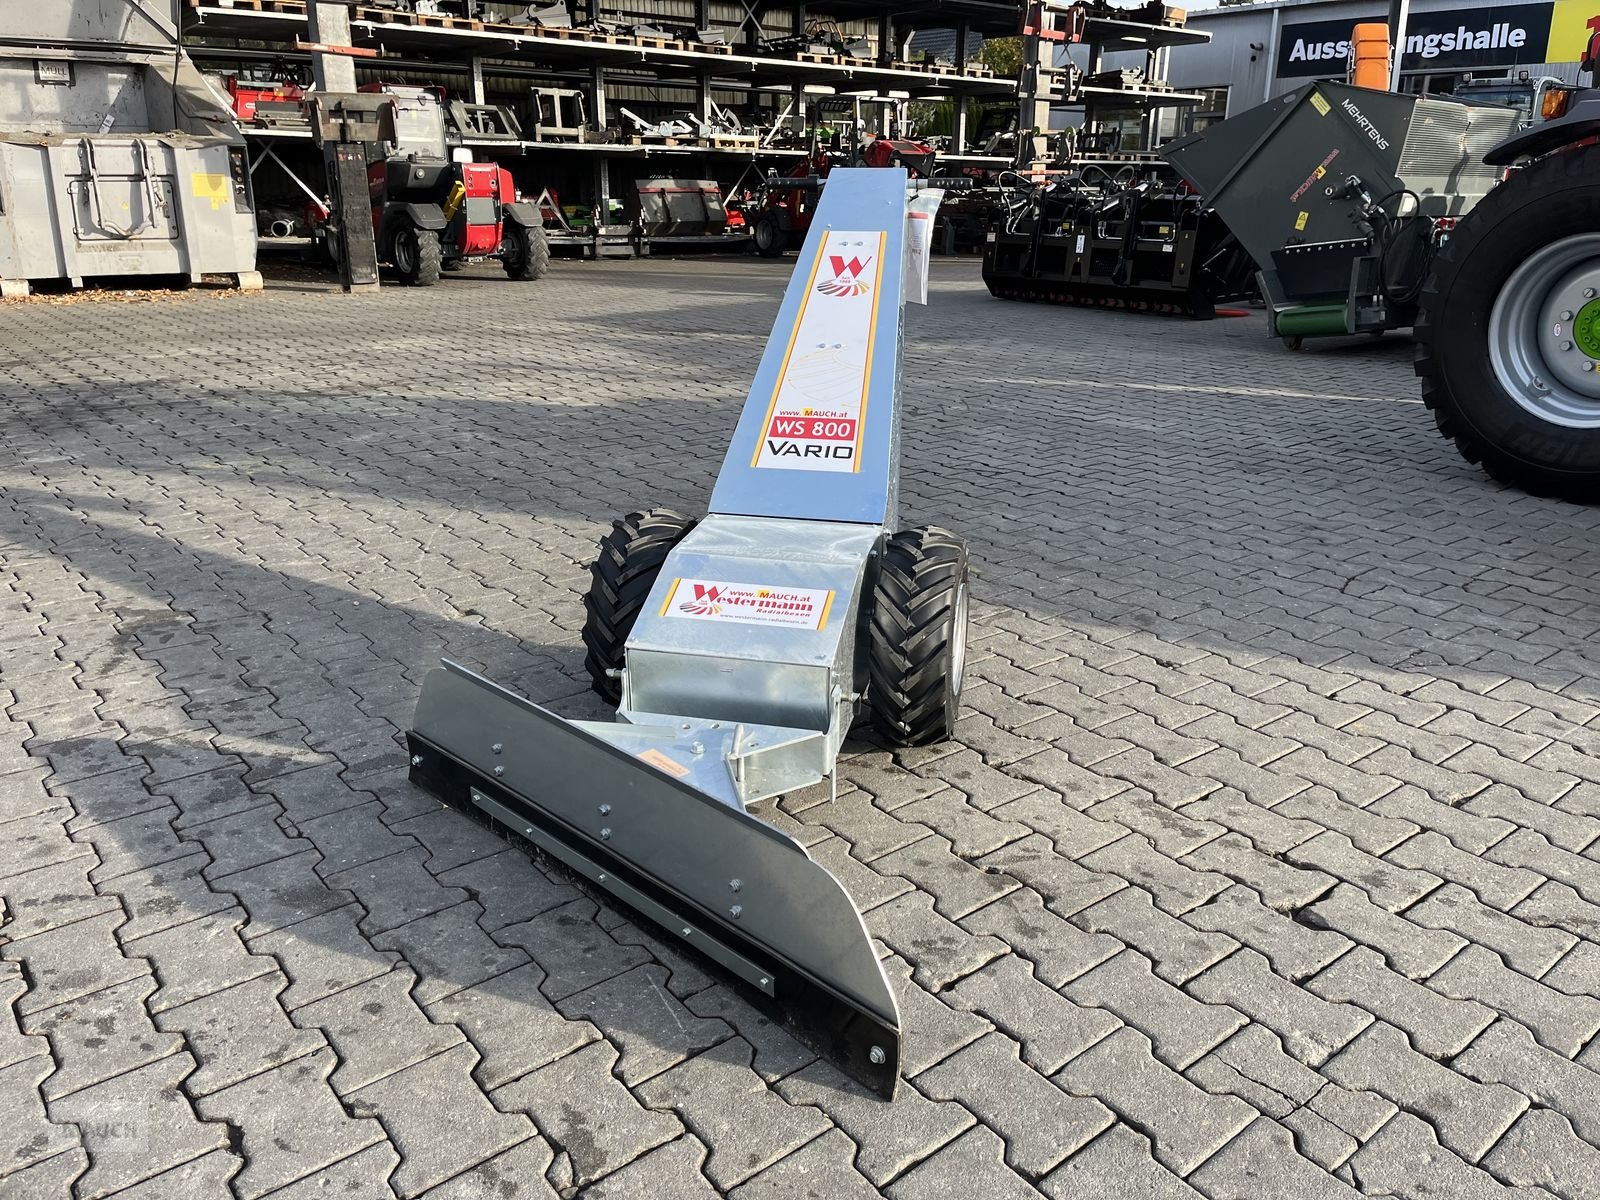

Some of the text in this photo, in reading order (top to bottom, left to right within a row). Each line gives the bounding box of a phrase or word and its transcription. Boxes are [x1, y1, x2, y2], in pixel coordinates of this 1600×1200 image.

[1288, 22, 1527, 62] Aussngshalle
[1341, 98, 1390, 151] MEHRTENS
[776, 419, 851, 438] WS 800
[767, 440, 853, 460] VARIO
[693, 584, 813, 612] Westermann
[756, 608, 811, 617] Radialbesen
